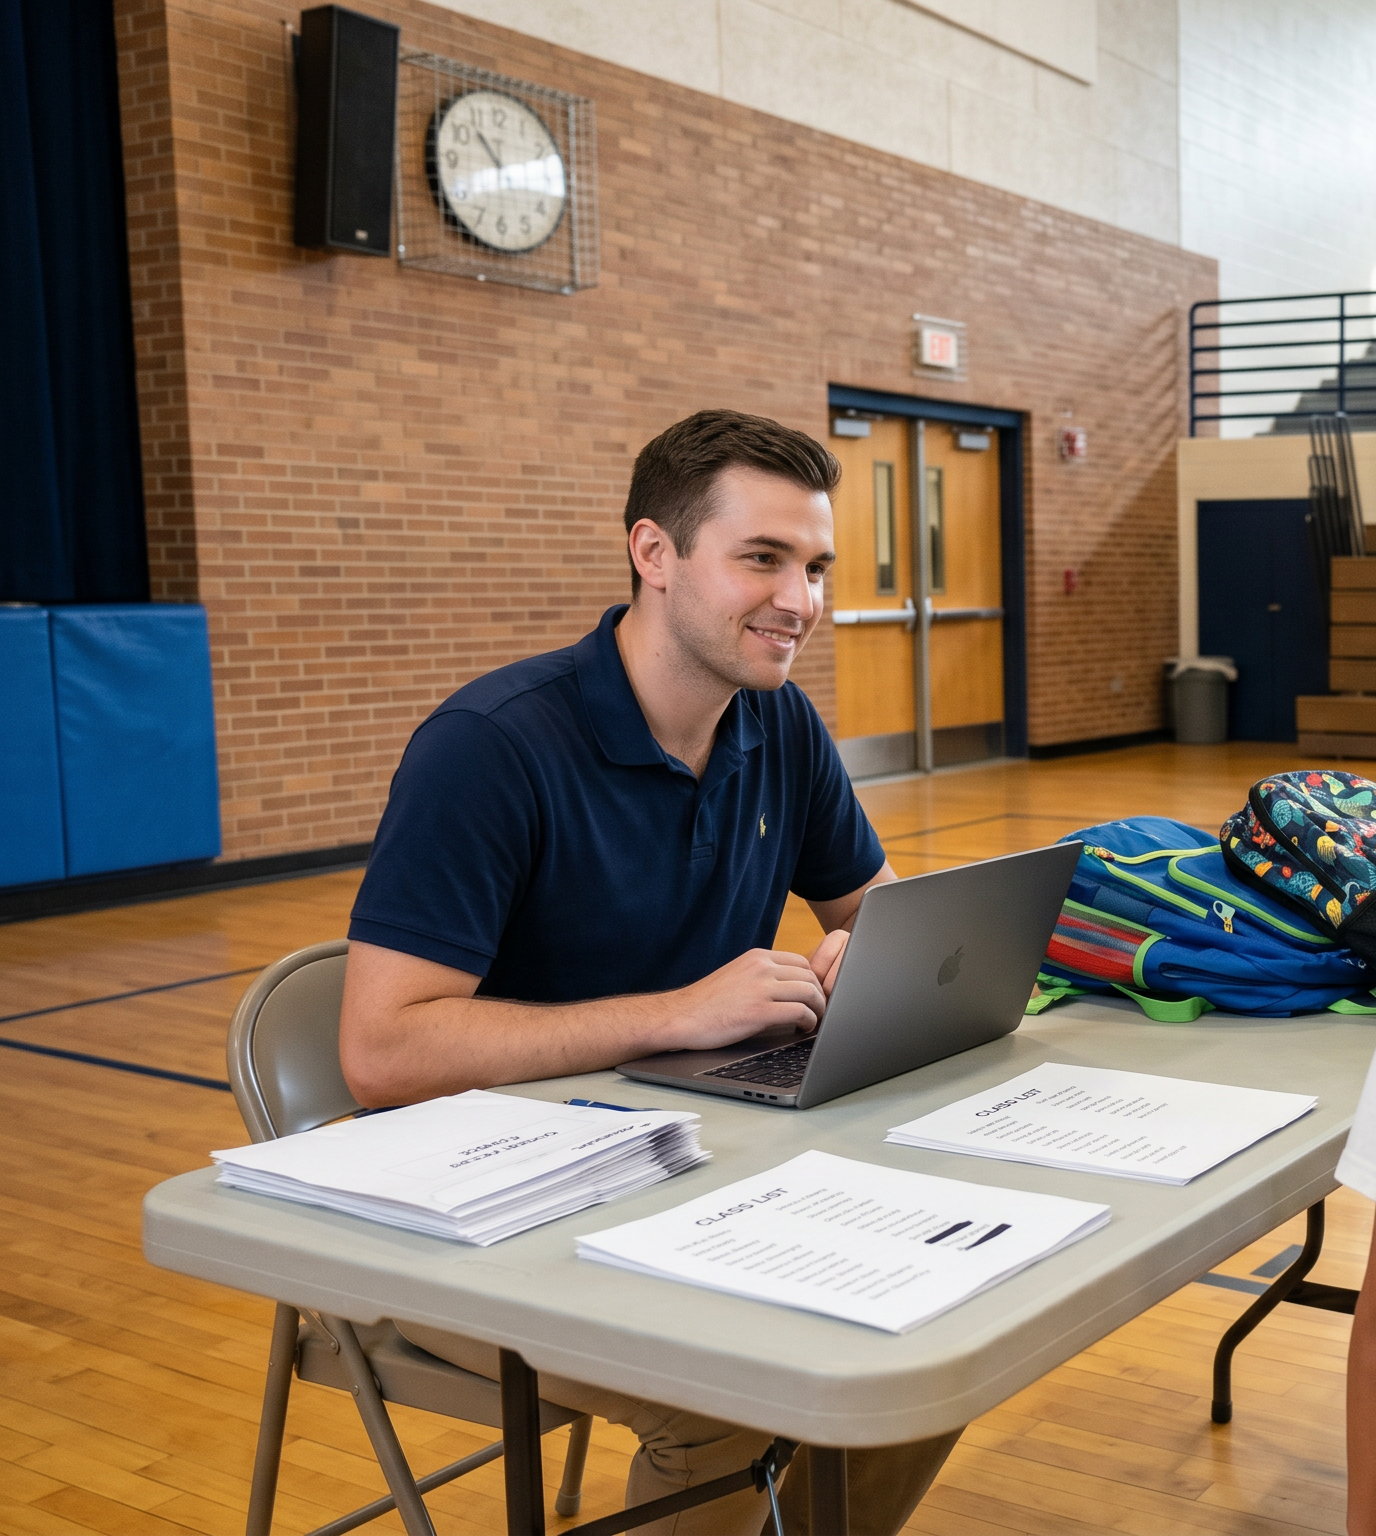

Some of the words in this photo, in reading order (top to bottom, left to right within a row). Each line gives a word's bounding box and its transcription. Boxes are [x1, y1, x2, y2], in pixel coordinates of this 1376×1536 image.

[451, 120, 470, 146] 10
[446, 149, 459, 170] 9
[472, 204, 486, 230] 7
[496, 215, 508, 236] 6
[519, 214, 531, 236] 5
[695, 1202, 744, 1226] CLASS
[750, 1187, 789, 1204] LIST
